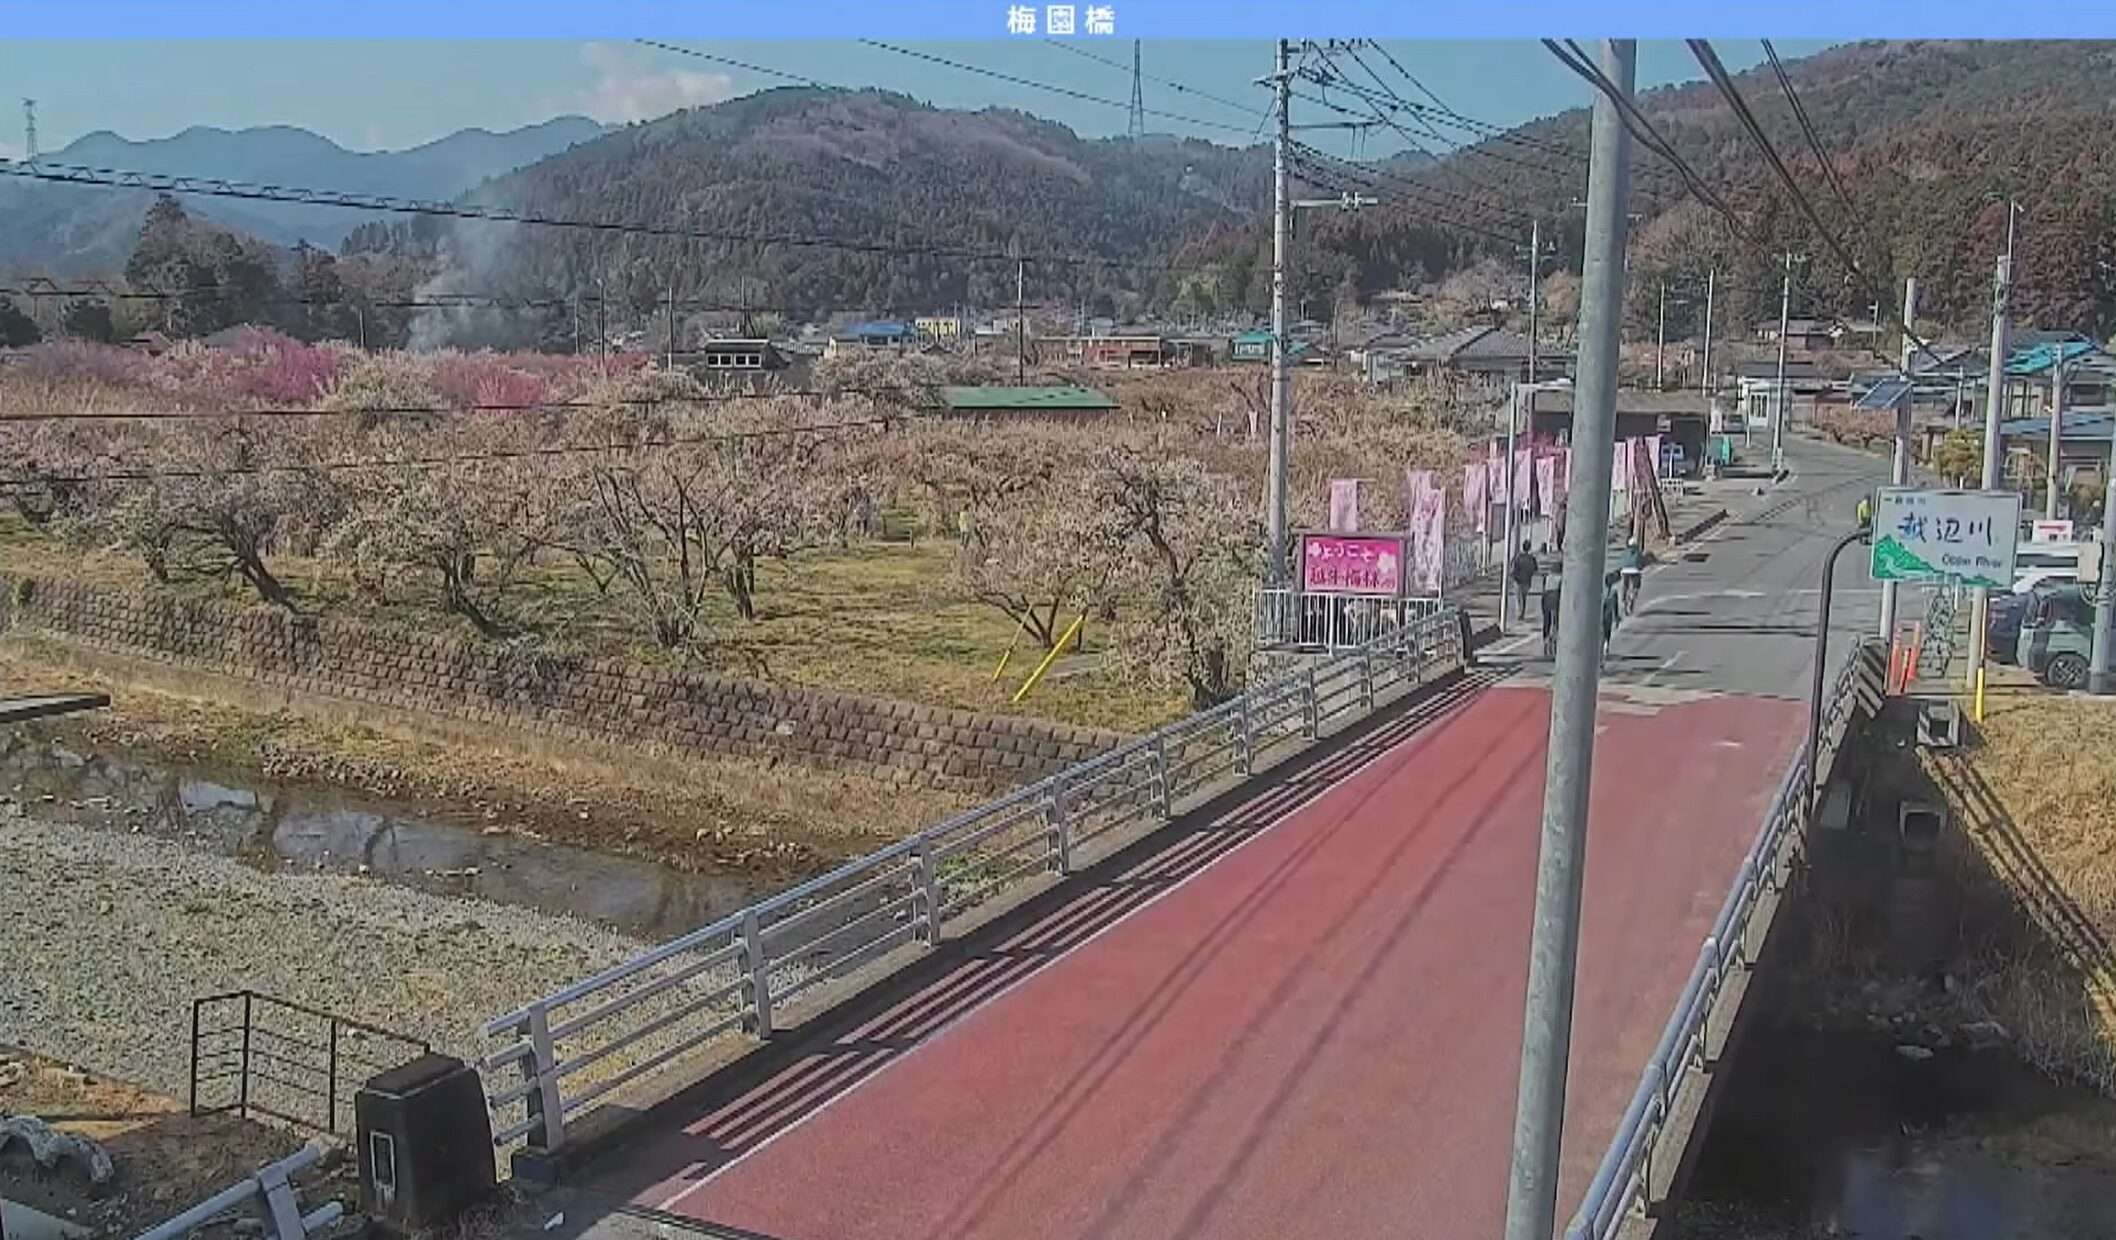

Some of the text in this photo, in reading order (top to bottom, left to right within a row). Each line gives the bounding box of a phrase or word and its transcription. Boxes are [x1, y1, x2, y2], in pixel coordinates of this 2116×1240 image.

[1897, 511, 1993, 547] 越辺川
[1320, 541, 1376, 562] ようこそ
